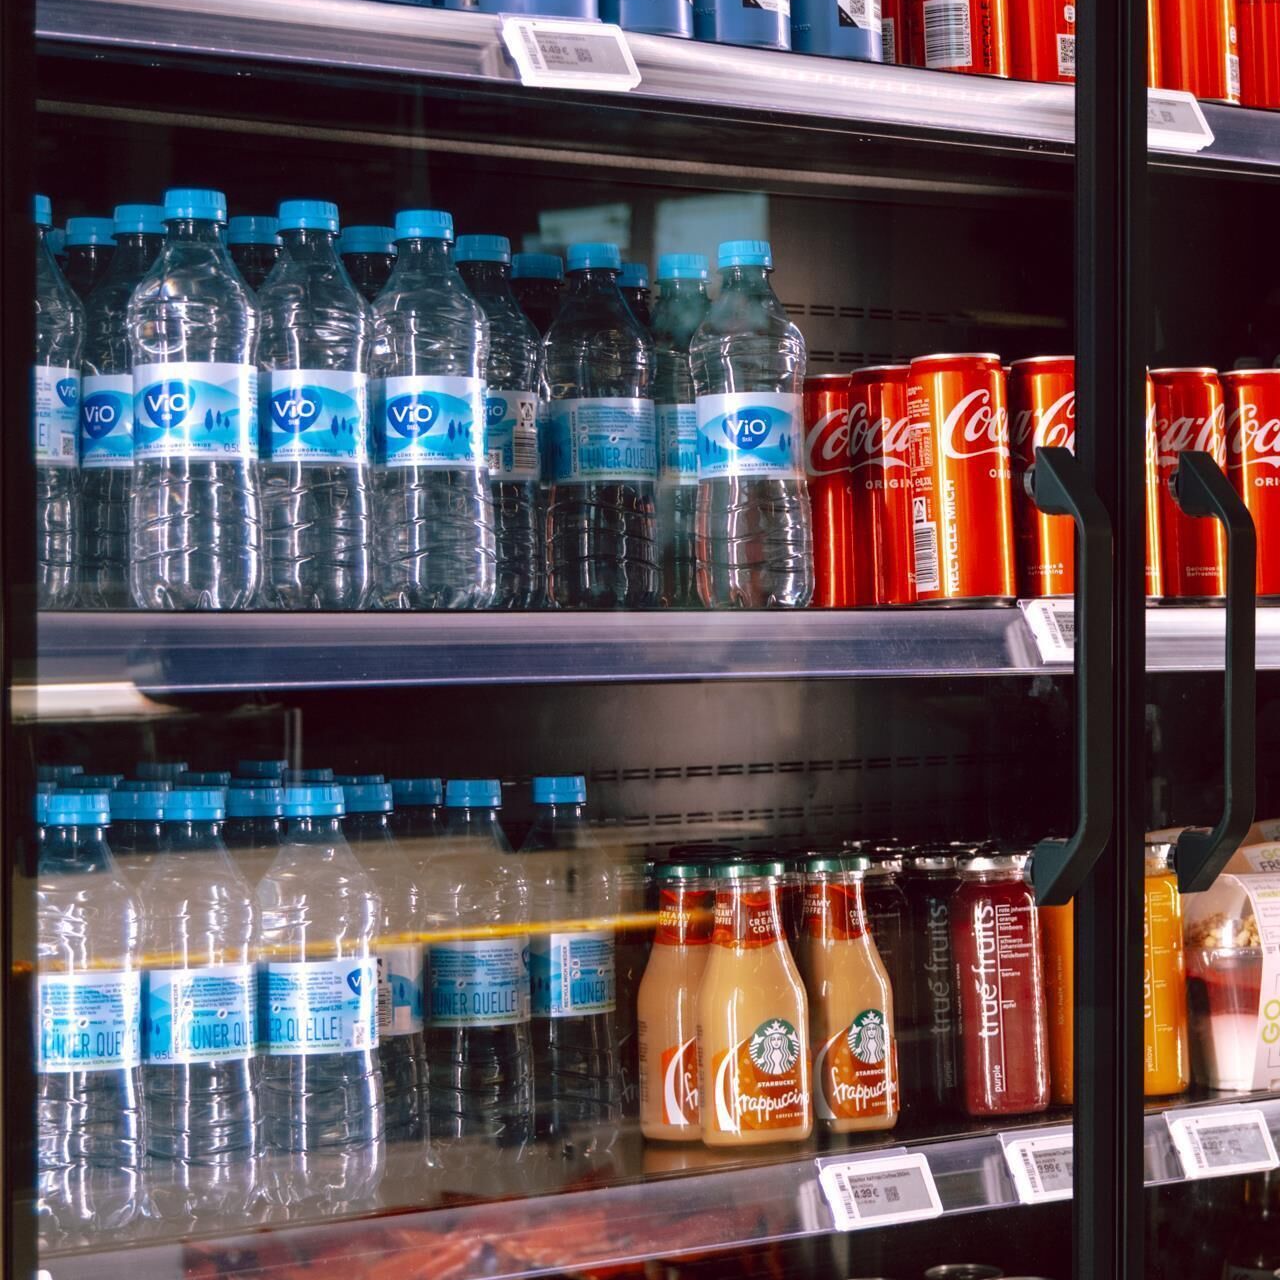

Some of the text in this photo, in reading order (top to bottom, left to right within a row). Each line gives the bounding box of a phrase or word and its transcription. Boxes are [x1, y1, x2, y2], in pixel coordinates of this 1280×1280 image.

[980, 0, 991, 68] RECYCLE
[148, 393, 188, 412] ViO
[275, 399, 316, 419] ViO
[84, 405, 115, 423] ViO
[391, 405, 433, 423] ViO
[725, 419, 766, 436] ViO
[944, 479, 960, 592] RECYCLE MICH
[924, 898, 950, 1035] true fruits
[972, 898, 999, 1038] true fruits
[472, 989, 517, 1016] QUELLE
[1003, 1002, 1017, 1010] apfel
[757, 1079, 797, 1088] STARBUCKS
[994, 1065, 1002, 1093] purple
[854, 1188, 873, 1199] 4.39
